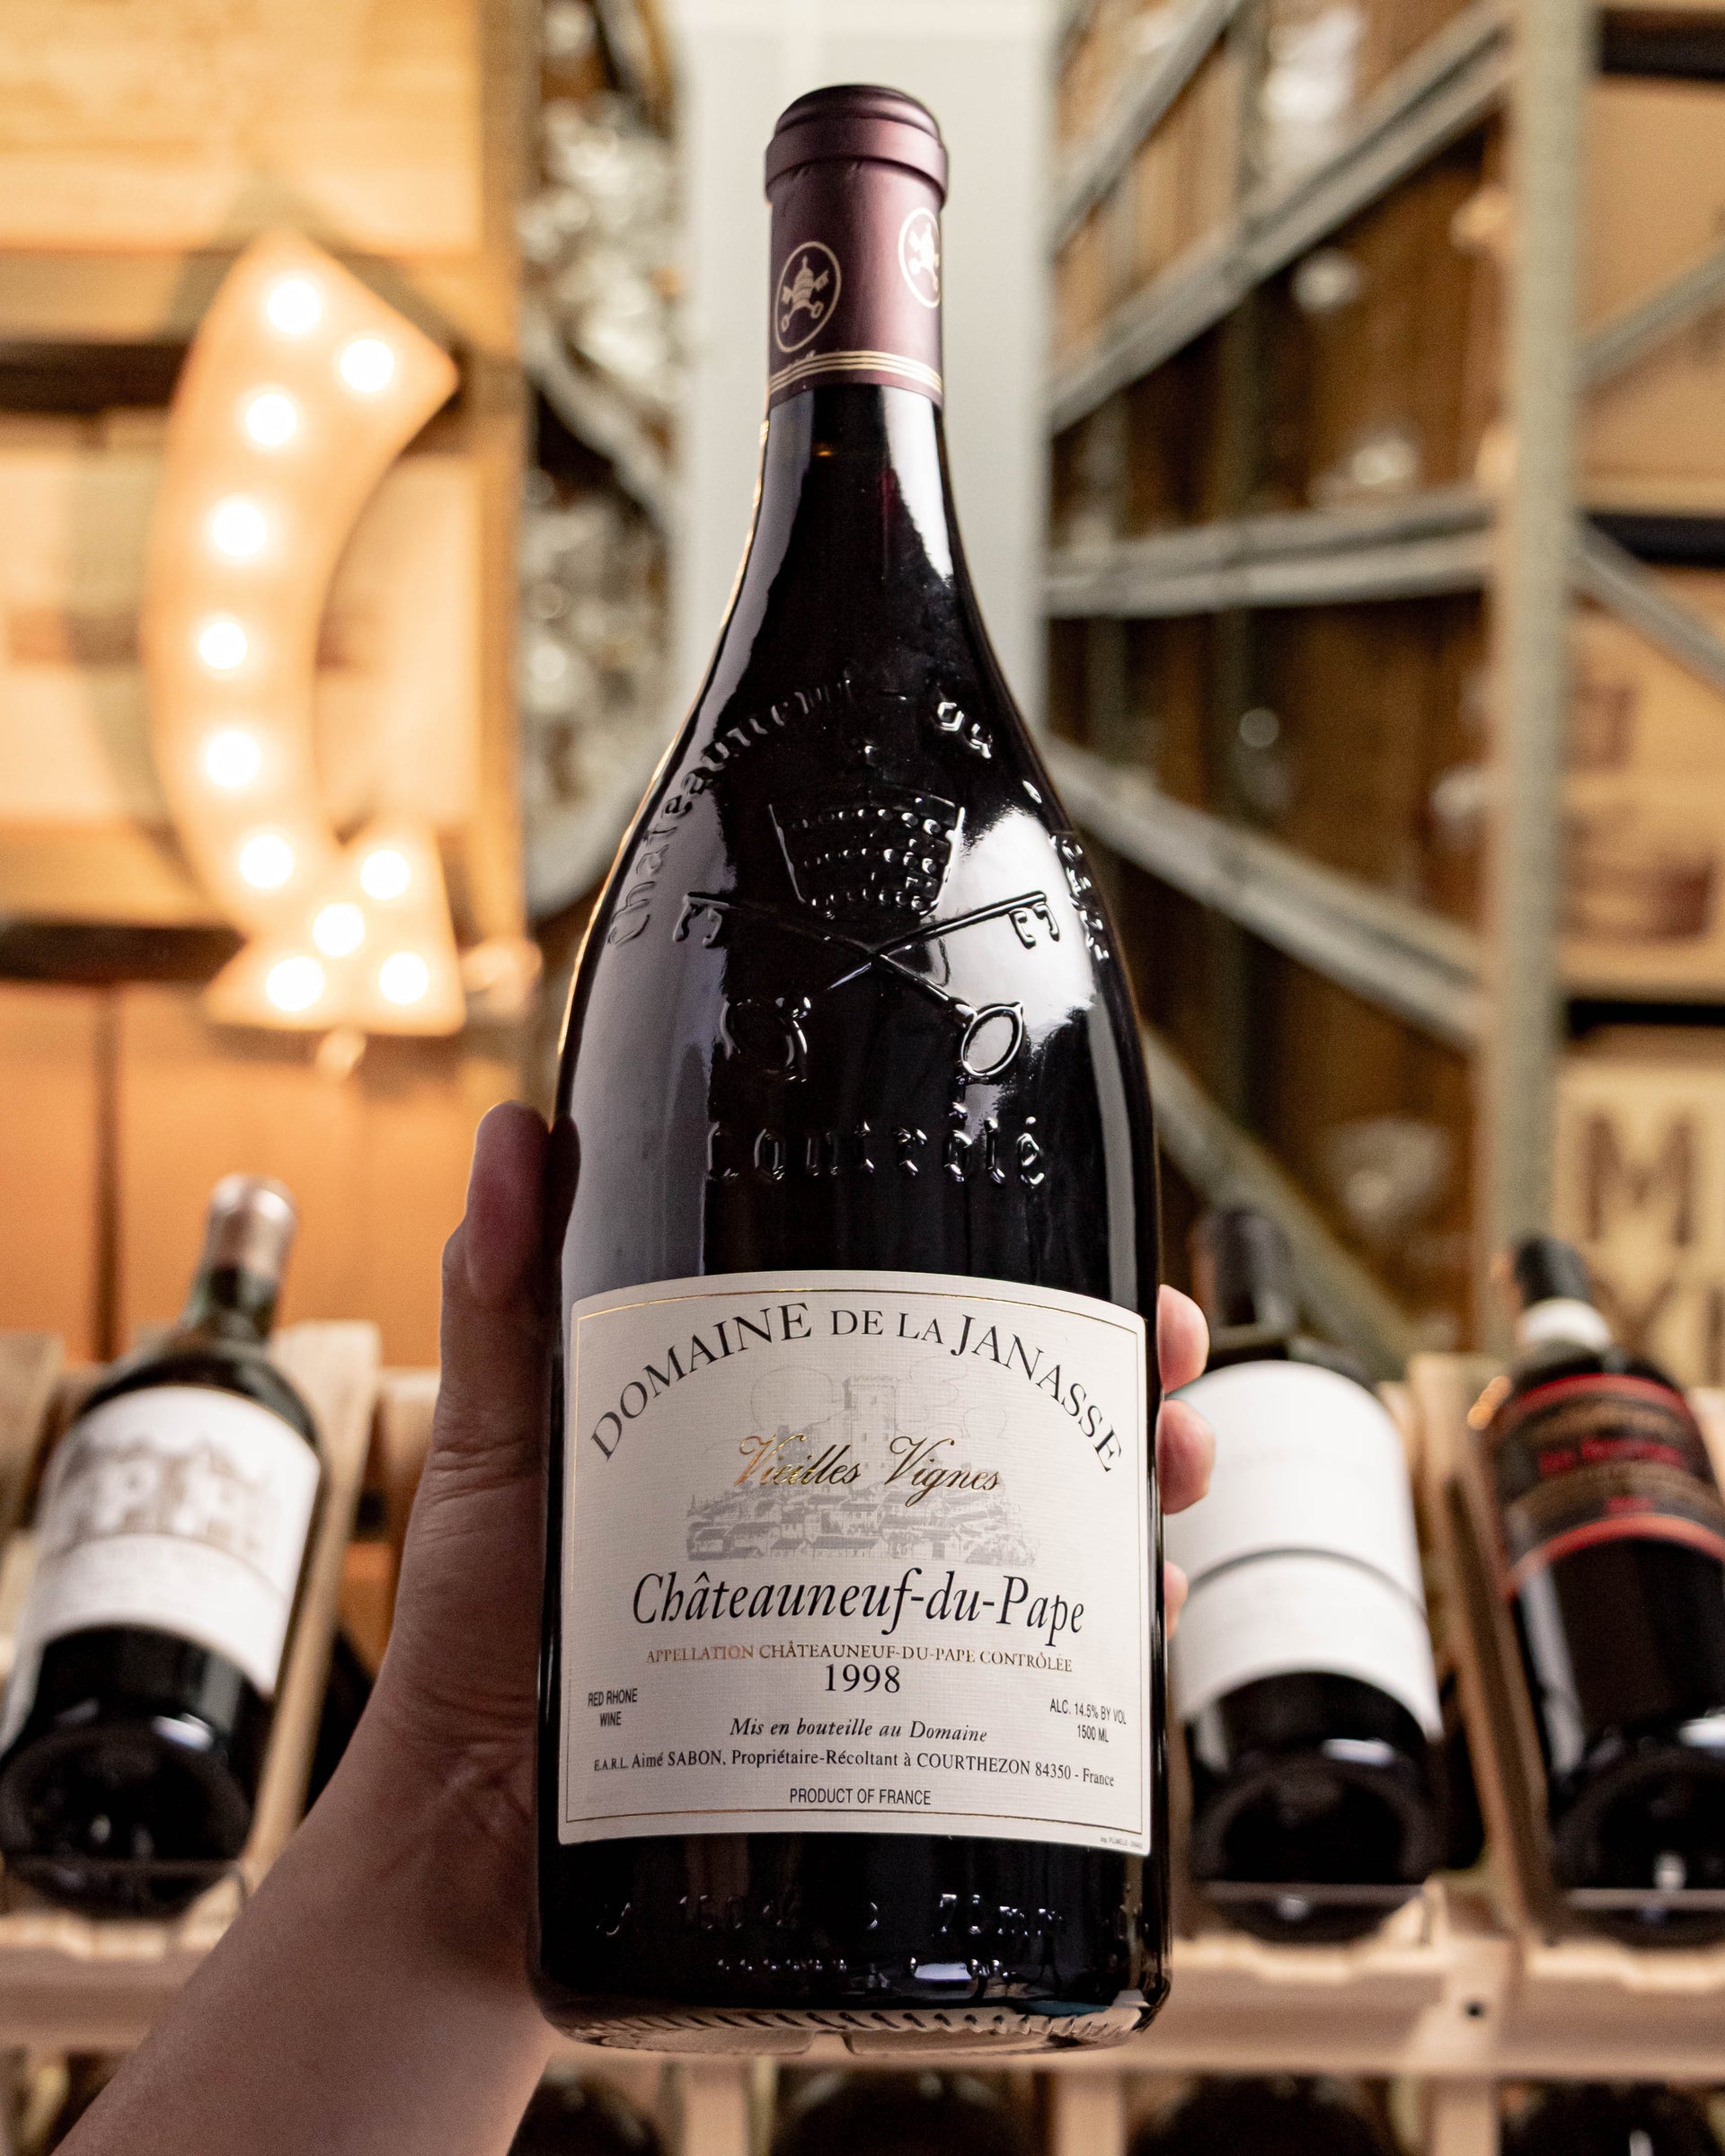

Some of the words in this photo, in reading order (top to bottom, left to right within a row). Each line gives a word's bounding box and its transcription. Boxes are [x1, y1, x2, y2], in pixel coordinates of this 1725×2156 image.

[591, 1303, 811, 1462] DOMAINE
[831, 1310, 883, 1336] DE
[897, 1312, 943, 1345] LA
[951, 1314, 1122, 1472] JANASSE
[733, 1433, 861, 1486] Vieilles
[884, 1436, 1000, 1508] Vignes
[632, 1567, 1084, 1647] Châteauneuf-du-Pape
[646, 1644, 754, 1663] APPELLATION
[759, 1640, 975, 1662] CHÂTEAUNEUF-DU-PAPE
[979, 1649, 1073, 1673] CONTRÔLÉE
[825, 1664, 900, 1693] 1998
[588, 1692, 605, 1707] RED
[606, 1688, 638, 1705] RHONE
[1049, 1698, 1071, 1714] ALC.
[1075, 1703, 1099, 1720] 14.5%
[1101, 1705, 1111, 1722] BY
[1112, 1708, 1127, 1725] VOL
[599, 1711, 623, 1727] WINE
[730, 1718, 763, 1736] Mis
[770, 1723, 791, 1736] en
[796, 1717, 873, 1737] bouteille
[879, 1726, 901, 1737] au
[909, 1720, 987, 1743] Domaine
[1077, 1724, 1097, 1741] 1500
[1098, 1727, 1110, 1743] ML
[594, 1758, 628, 1772] E.A.R.L.
[632, 1753, 664, 1769] Aimé
[668, 1750, 726, 1767] SABON,
[731, 1749, 898, 1769] Propriétaire-Récoltant
[903, 1752, 912, 1767] à
[916, 1753, 1031, 1775] COURTHEZON
[1035, 1763, 1072, 1780] 84350
[1083, 1768, 1115, 1787] France
[790, 1788, 853, 1804] PRODUCT
[856, 1789, 874, 1804] OF
[880, 1789, 931, 1805] FRANCE
